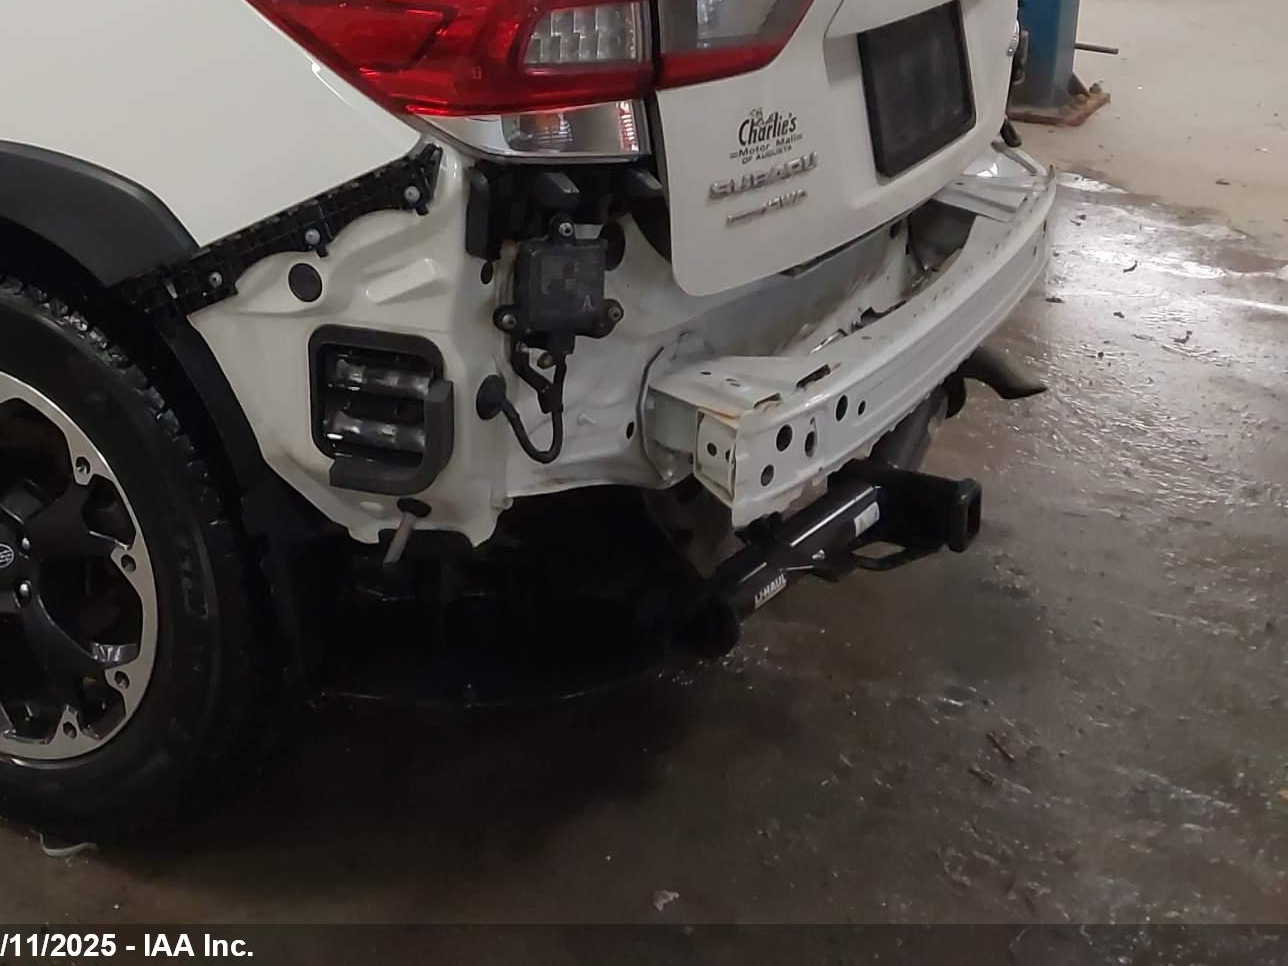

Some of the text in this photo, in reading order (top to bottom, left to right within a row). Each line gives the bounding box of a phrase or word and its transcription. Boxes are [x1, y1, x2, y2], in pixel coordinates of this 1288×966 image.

[738, 112, 798, 147] Charlie's
[738, 143, 771, 157] Motor
[754, 572, 788, 605] U-HAUL
